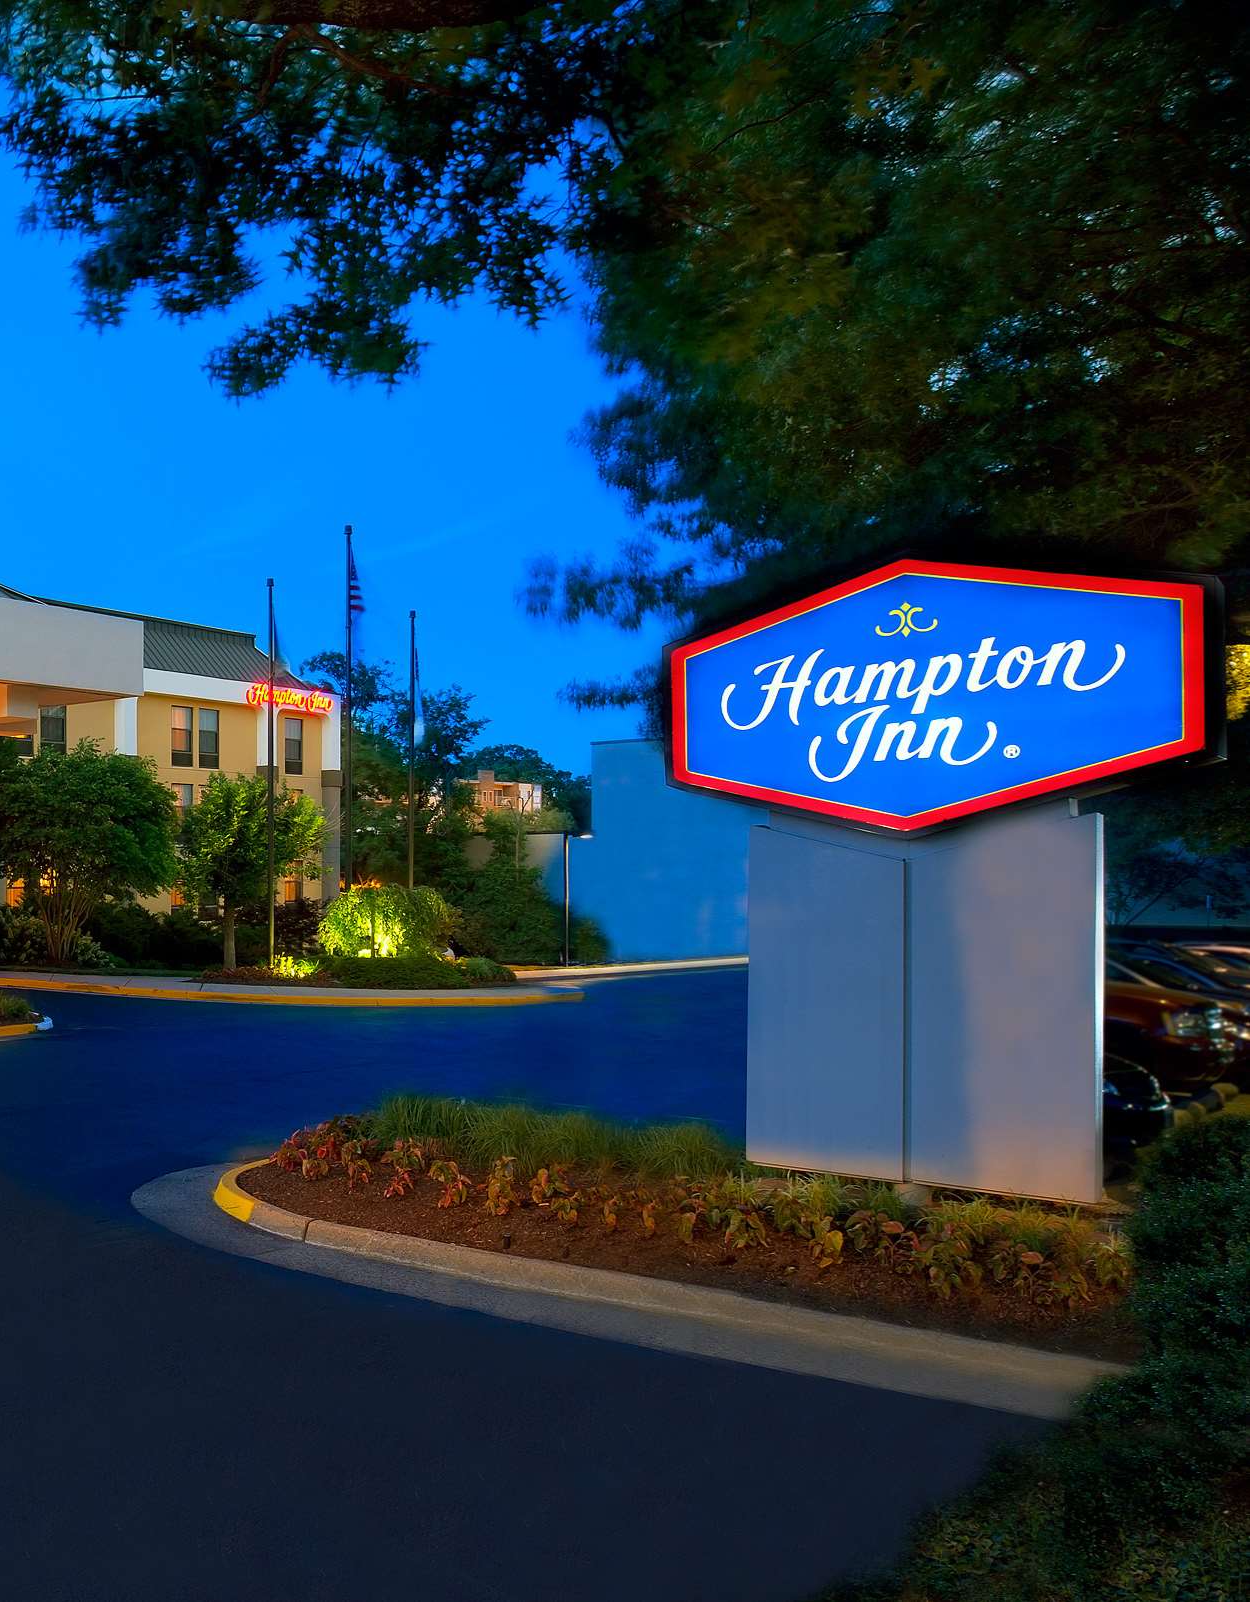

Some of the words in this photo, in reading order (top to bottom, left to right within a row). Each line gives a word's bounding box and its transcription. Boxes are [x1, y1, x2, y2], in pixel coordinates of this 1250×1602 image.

[307, 690, 334, 712] Inn
[721, 637, 1126, 730] Hampton
[808, 704, 998, 782] Inn
